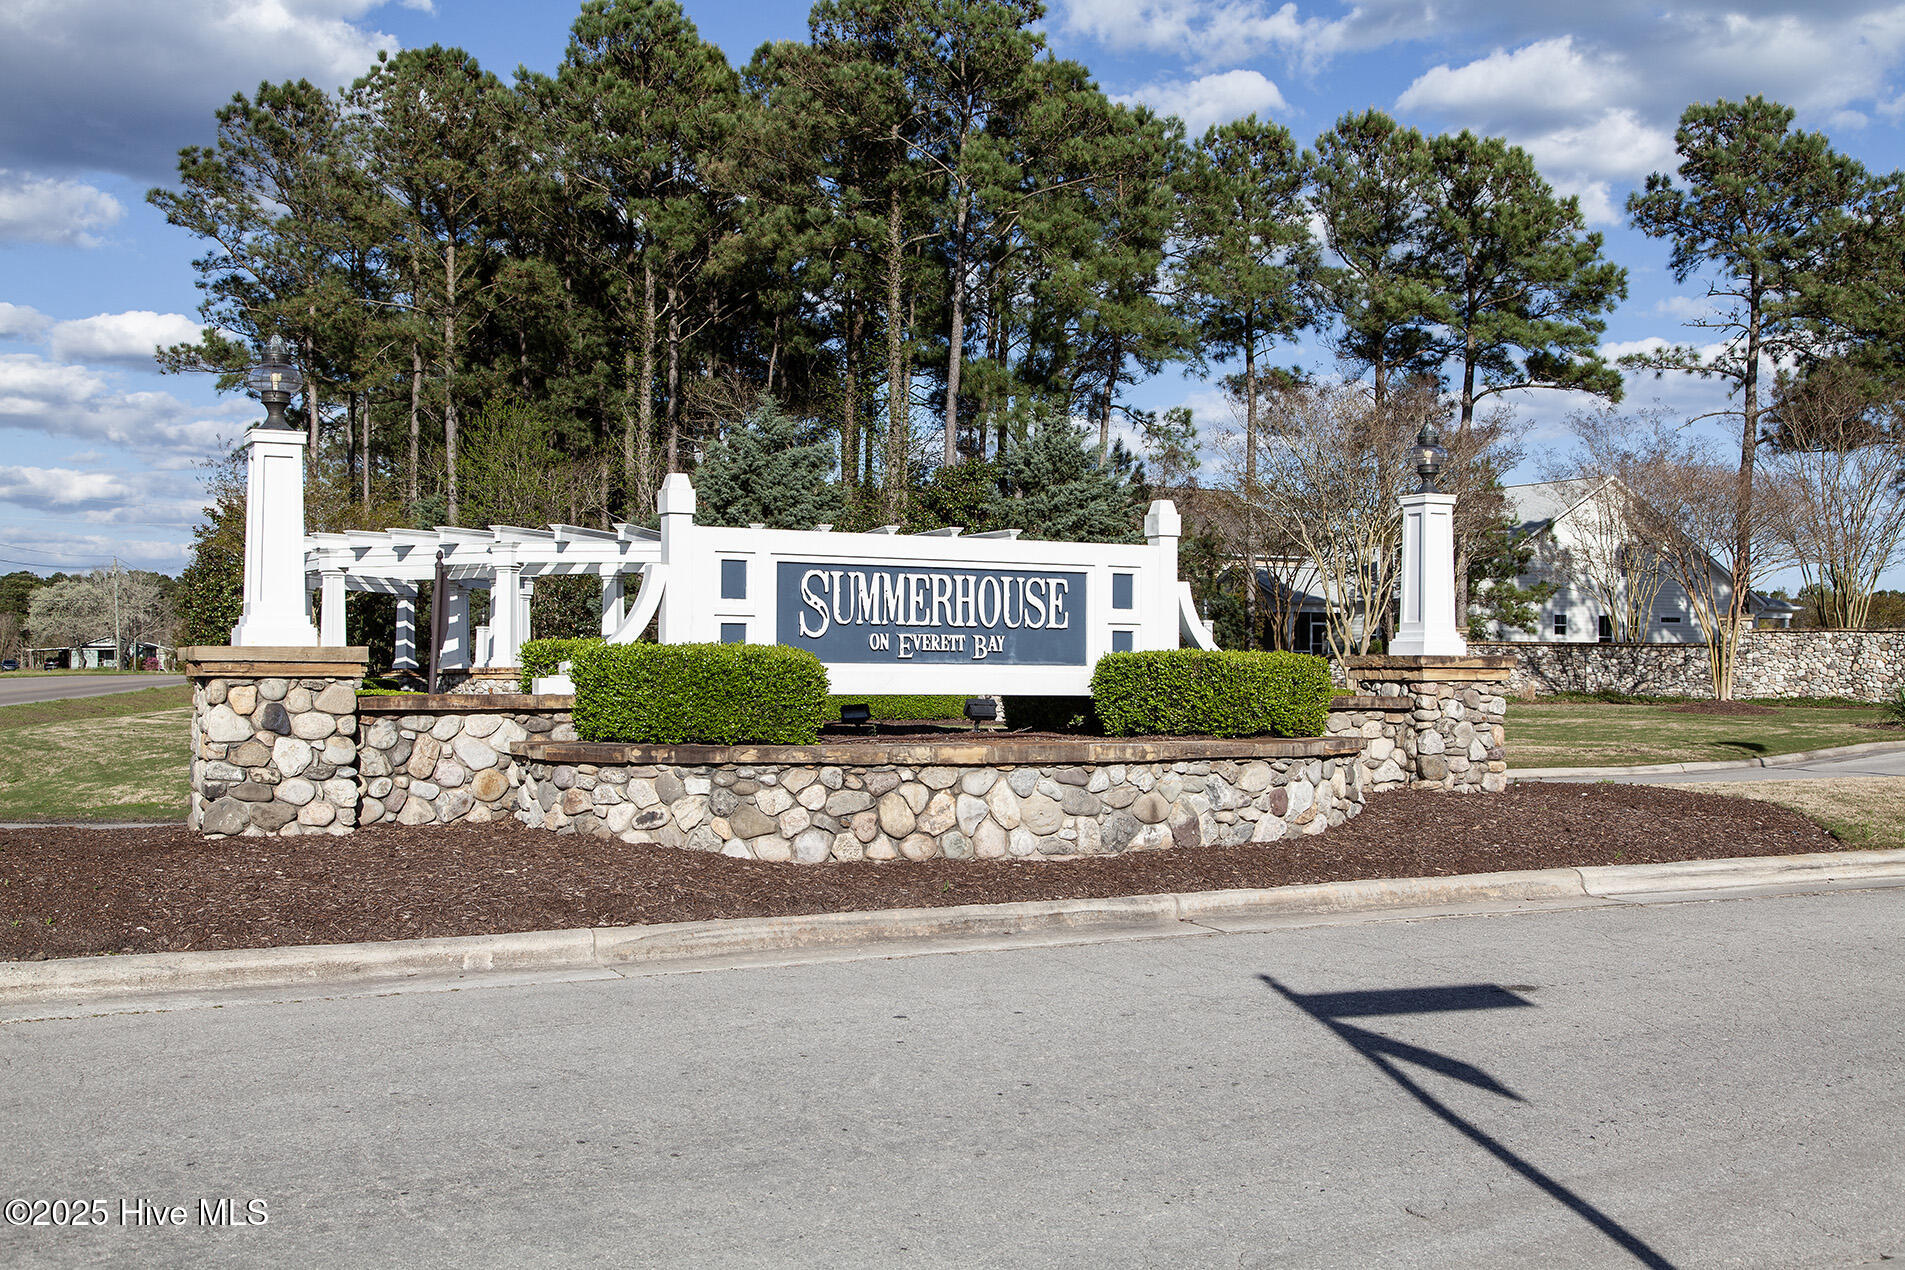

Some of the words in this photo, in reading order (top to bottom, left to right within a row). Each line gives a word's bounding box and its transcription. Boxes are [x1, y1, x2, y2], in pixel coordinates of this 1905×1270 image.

[799, 569, 1069, 638] SUMMERHOUSE
[869, 633, 890, 652] ON
[897, 633, 966, 659] EVERETT
[972, 634, 1006, 660] BAY
